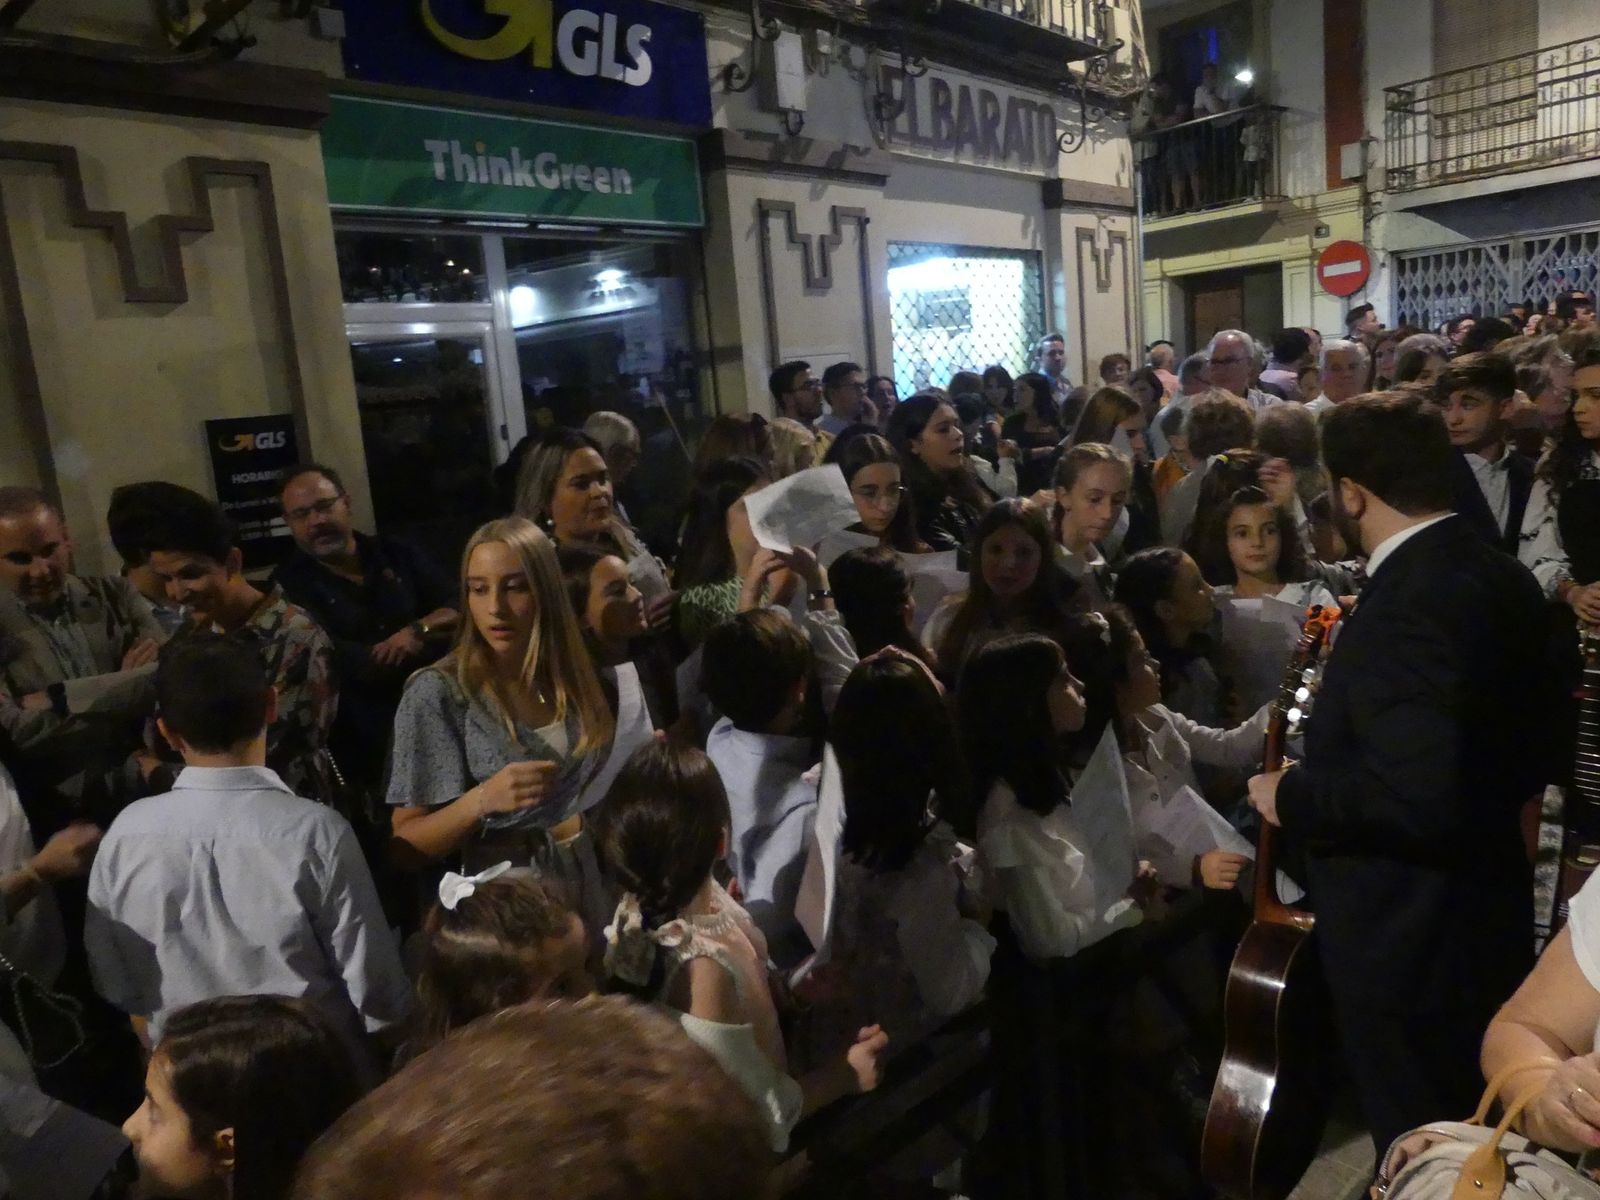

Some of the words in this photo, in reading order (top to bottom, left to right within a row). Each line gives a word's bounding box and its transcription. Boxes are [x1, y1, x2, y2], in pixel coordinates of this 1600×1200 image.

[557, 9, 652, 87] GLS
[929, 77, 1058, 169] BARATO
[424, 138, 633, 195] ThinkGreen
[255, 431, 286, 449] GLS
